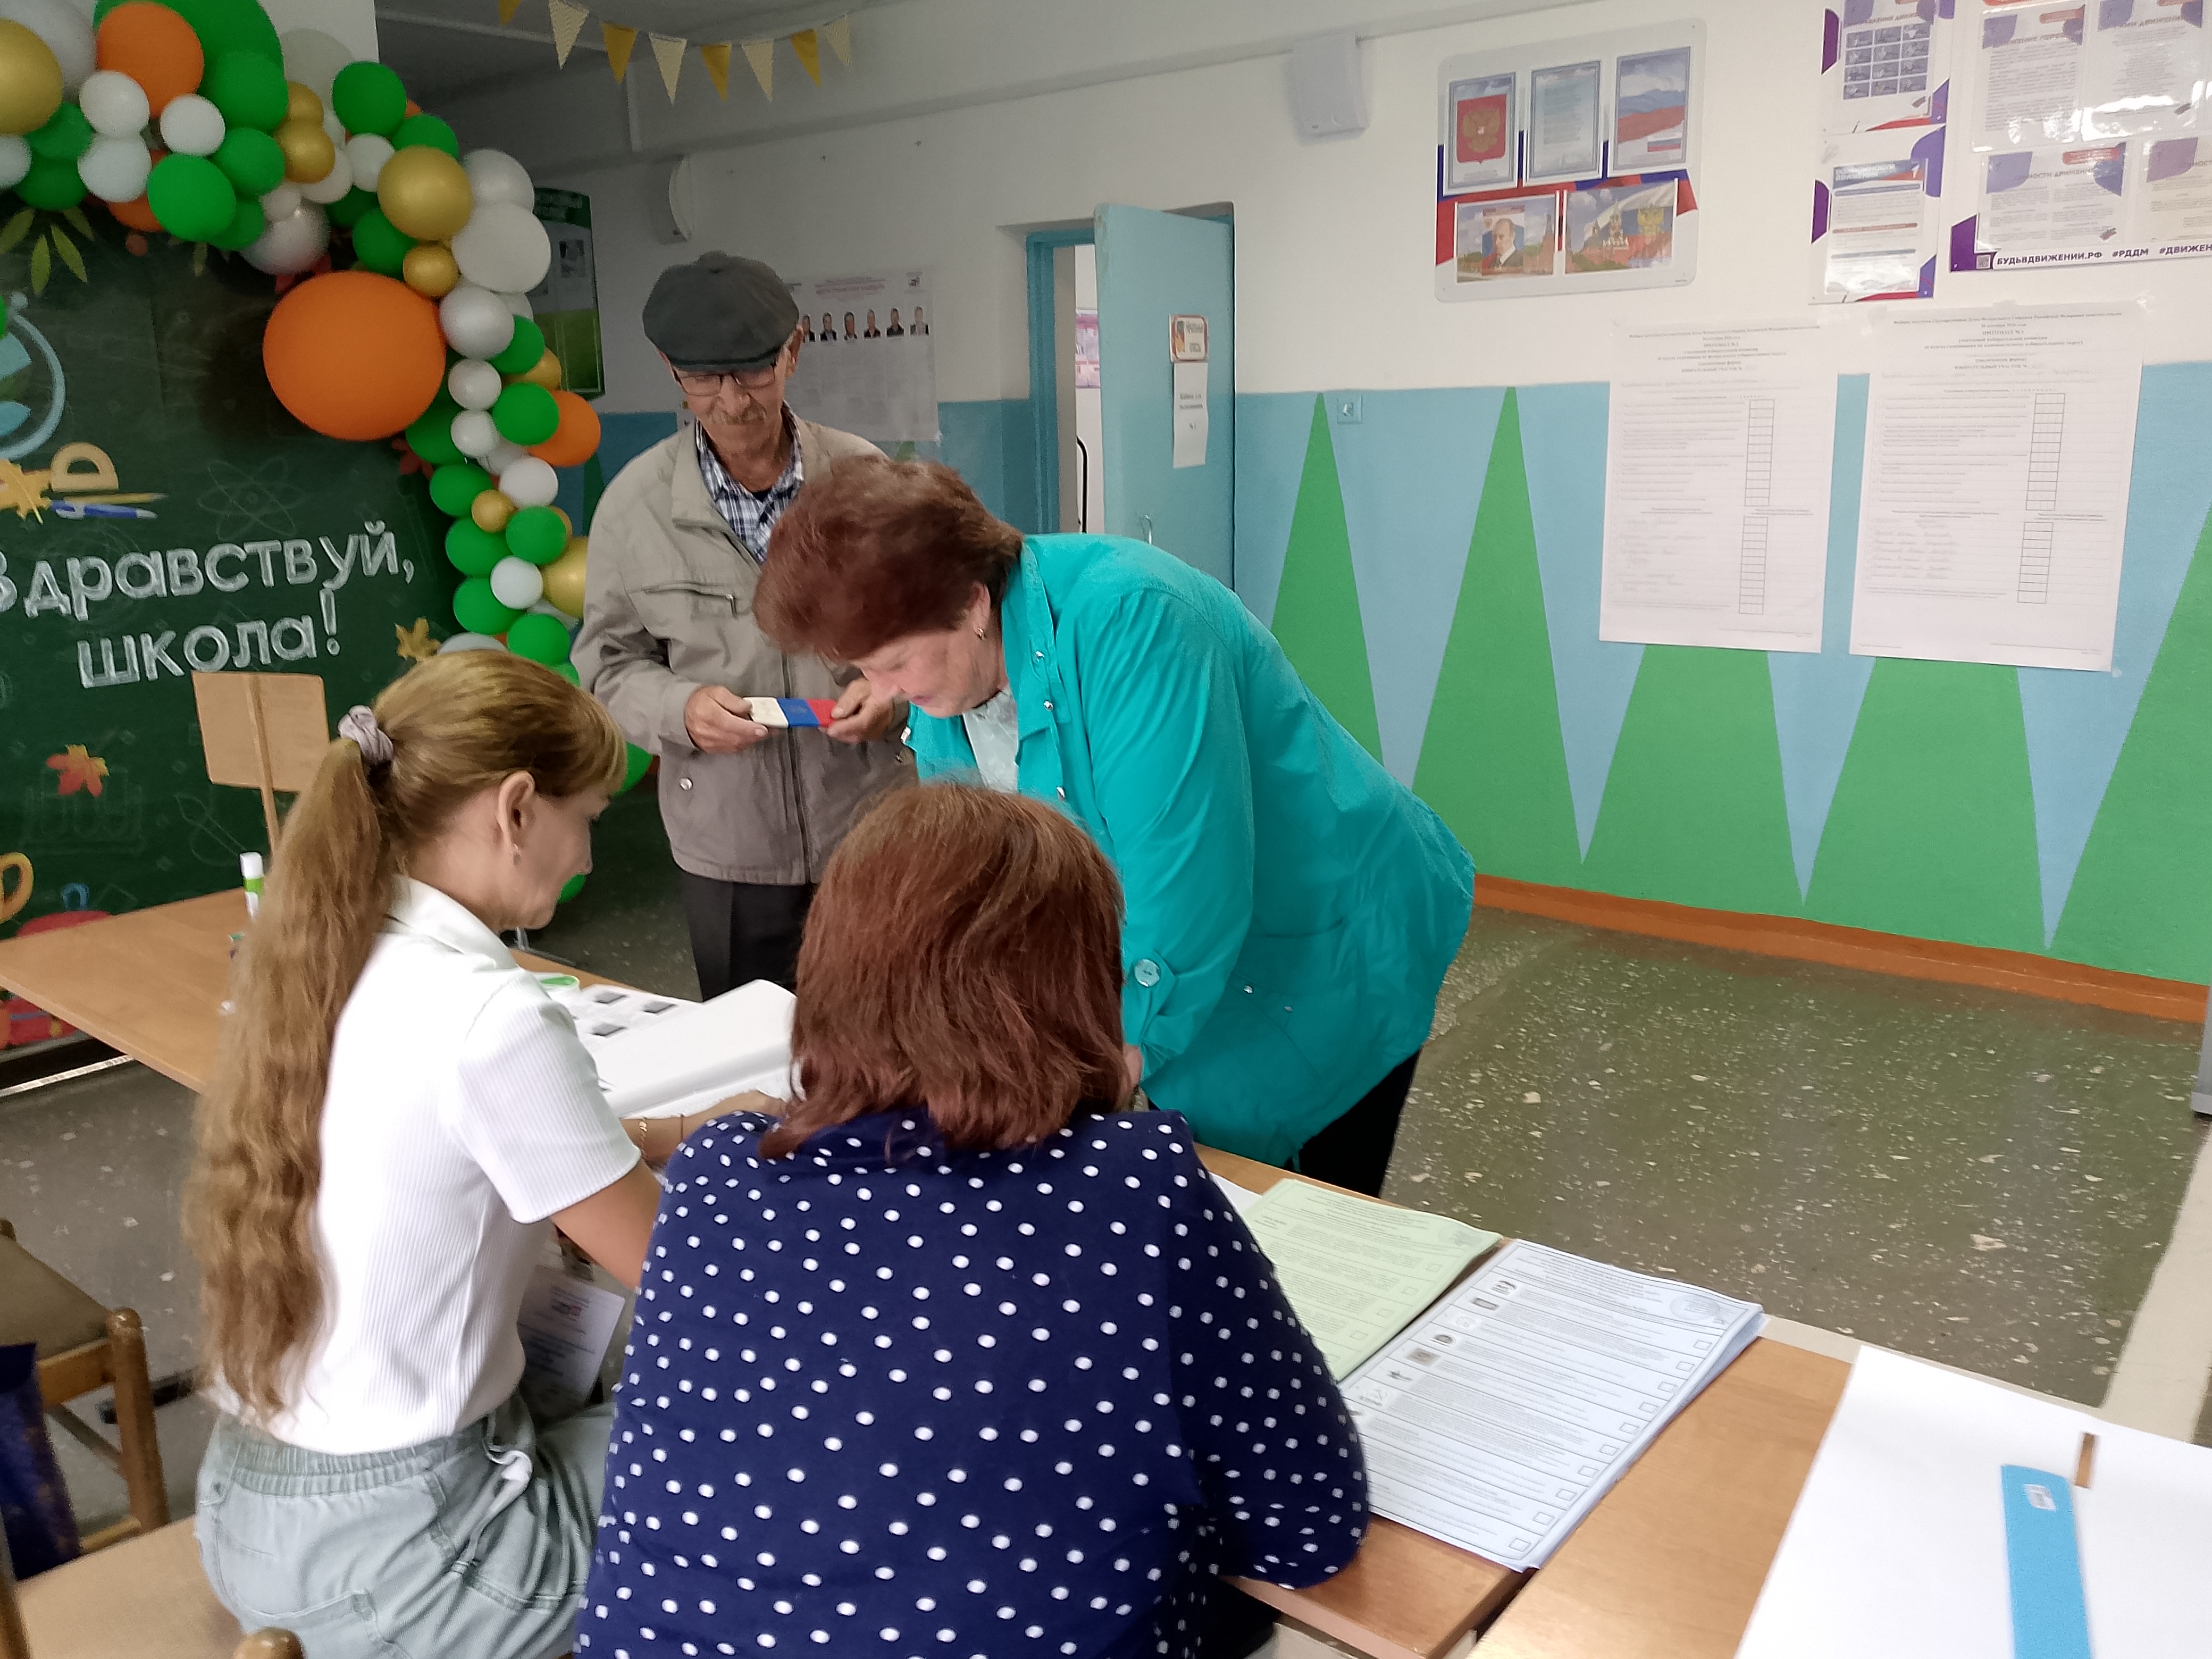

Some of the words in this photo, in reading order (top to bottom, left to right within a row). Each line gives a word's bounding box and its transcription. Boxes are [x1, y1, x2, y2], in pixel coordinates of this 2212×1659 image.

[1997, 251, 2103, 265] БУДЬВДВИЖЕНИИ.РФ
[2112, 248, 2149, 258] #РДДМ
[77, 589, 340, 689] школа!
